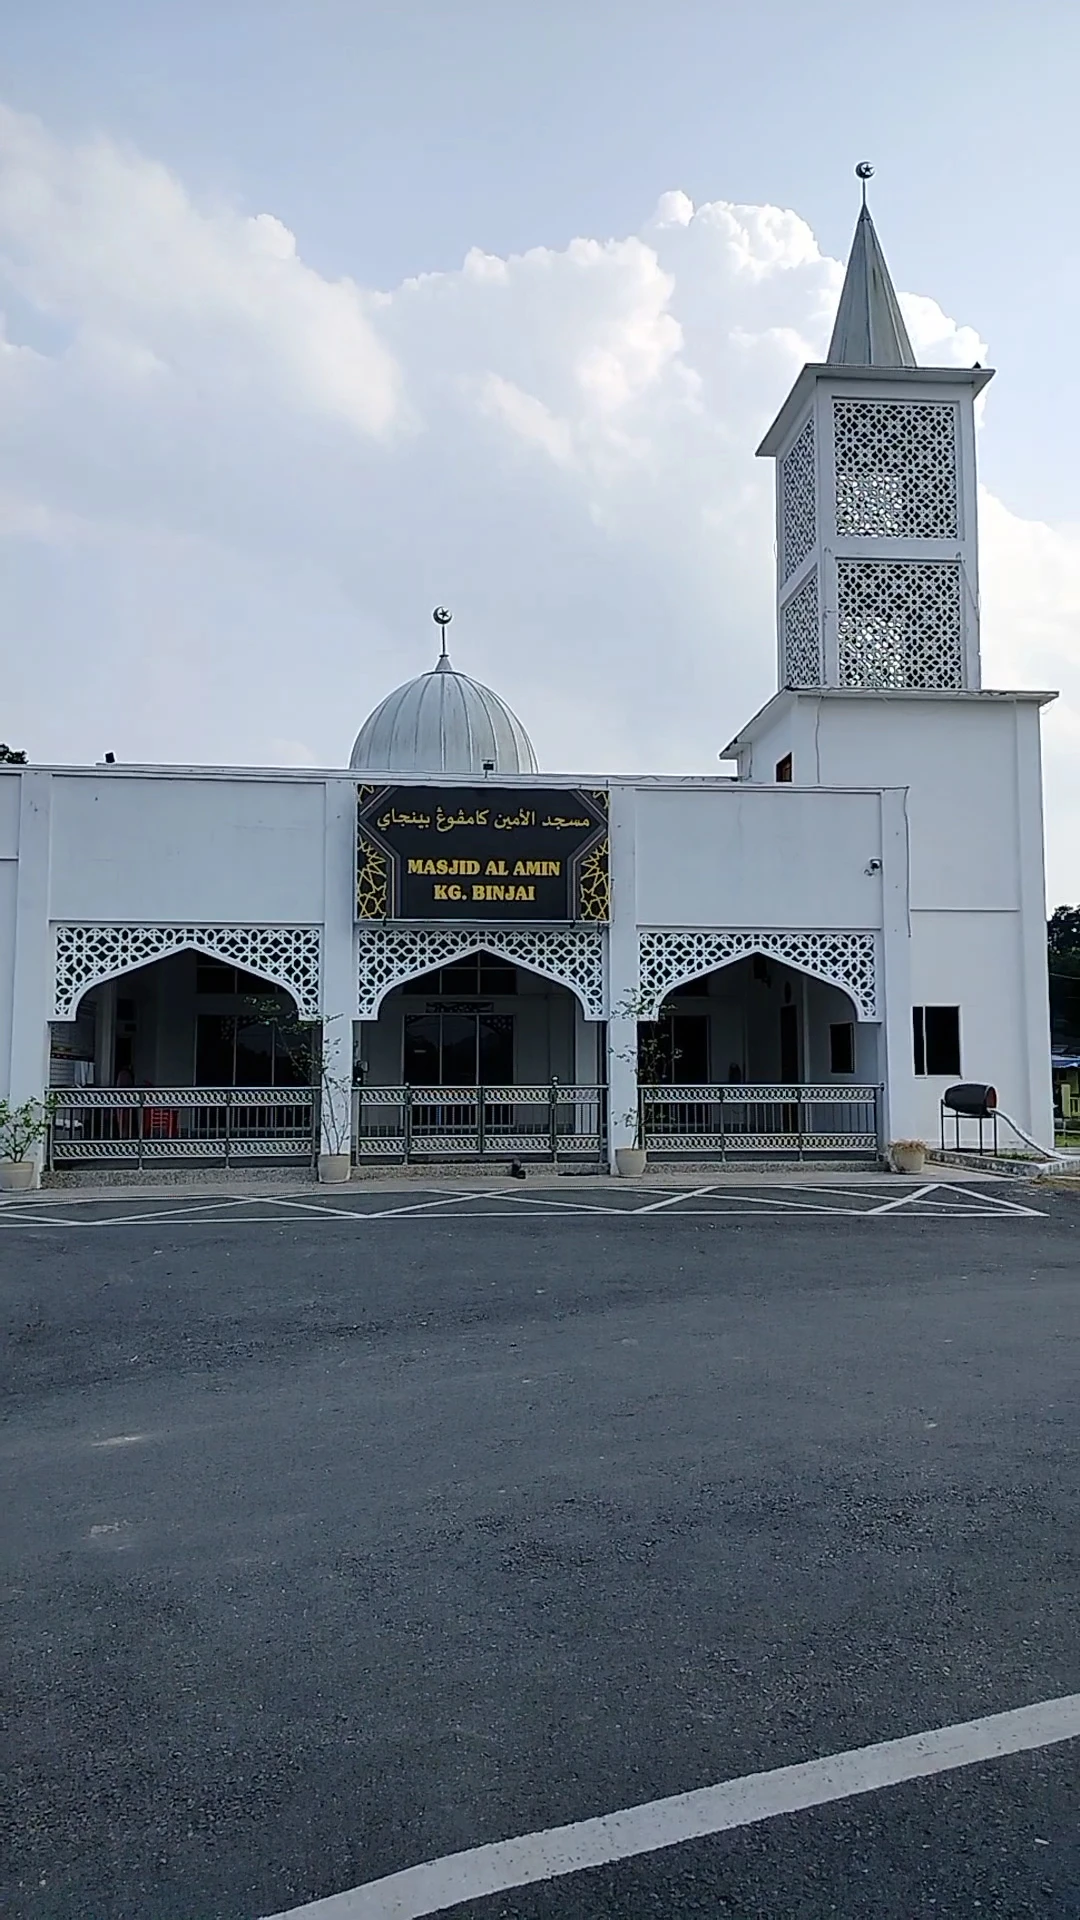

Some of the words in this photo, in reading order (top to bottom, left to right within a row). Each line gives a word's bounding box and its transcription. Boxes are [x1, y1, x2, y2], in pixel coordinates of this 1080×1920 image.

[377, 807, 430, 831] بينجاي
[542, 815, 590, 830] مسجد
[407, 859, 481, 875] MASJID
[485, 860, 509, 876] AL
[513, 861, 561, 876] AMIN
[434, 884, 467, 900] KG.
[472, 885, 535, 901] BINJAI
